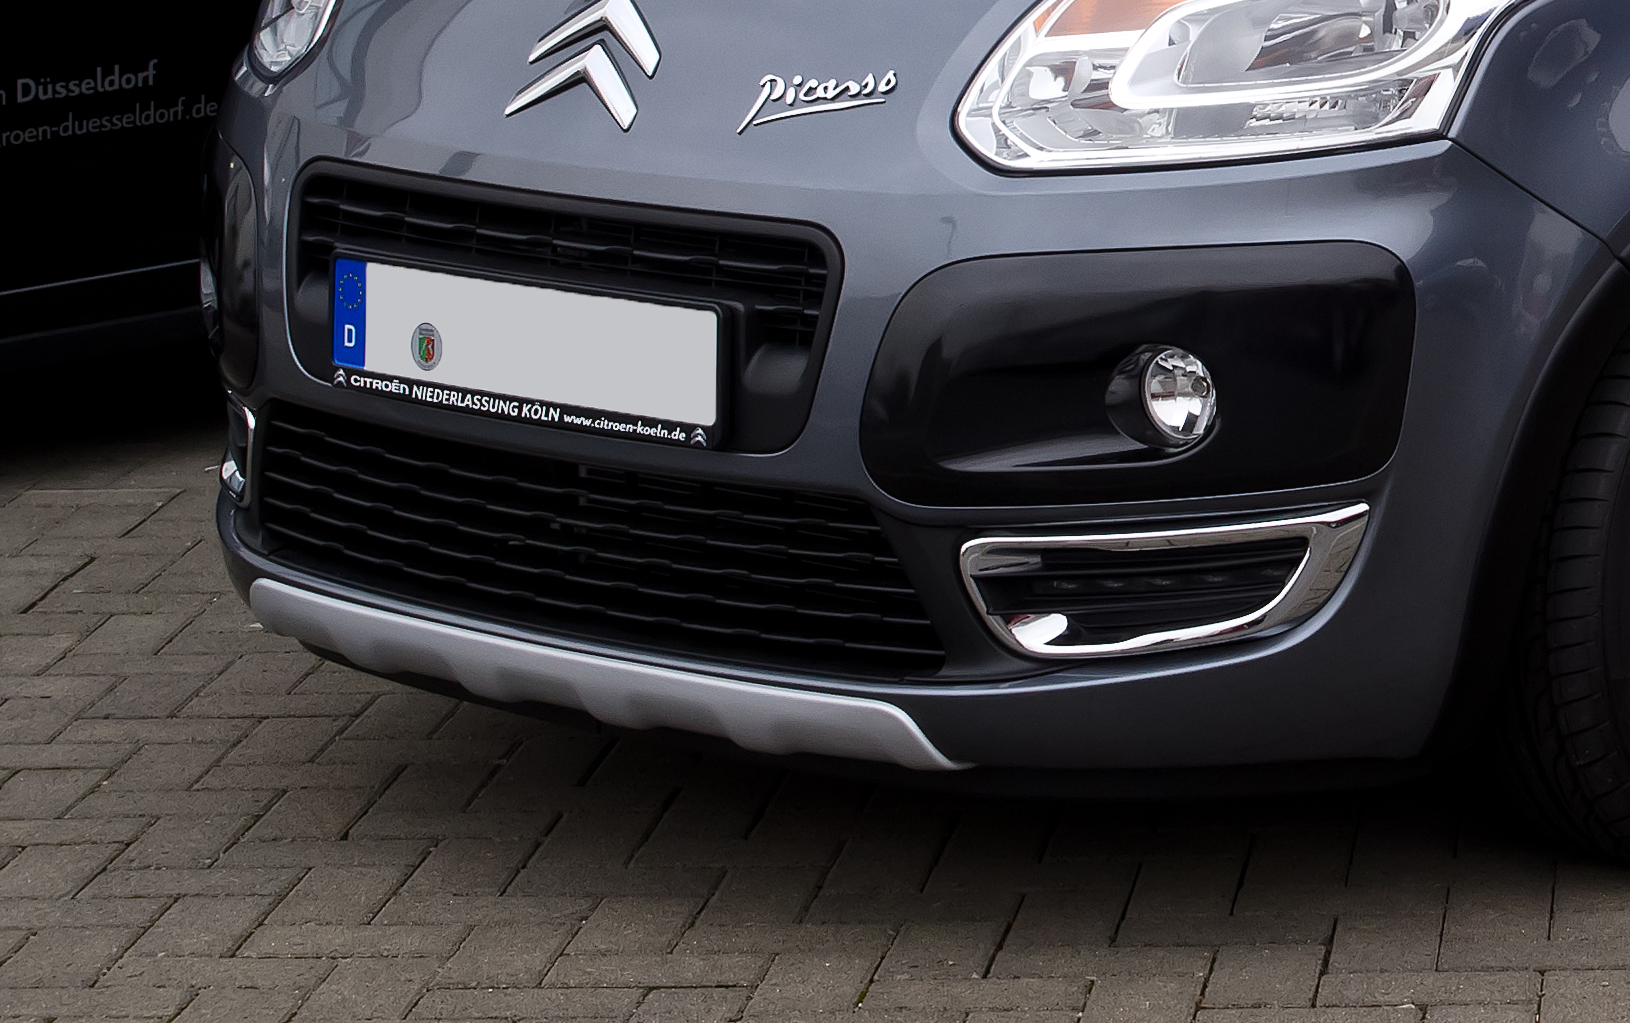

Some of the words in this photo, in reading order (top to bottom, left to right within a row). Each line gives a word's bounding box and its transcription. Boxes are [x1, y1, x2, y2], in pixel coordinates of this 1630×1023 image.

[16, 58, 159, 103] Düsseldorf
[736, 69, 898, 135] Picasso
[0, 94, 219, 147] roen-duesseldorf.de
[343, 323, 357, 348] D
[411, 383, 520, 417] NIEDERLASSUNG
[521, 401, 561, 423] KÖLN
[563, 413, 687, 442] www.citroen-koeln.de
